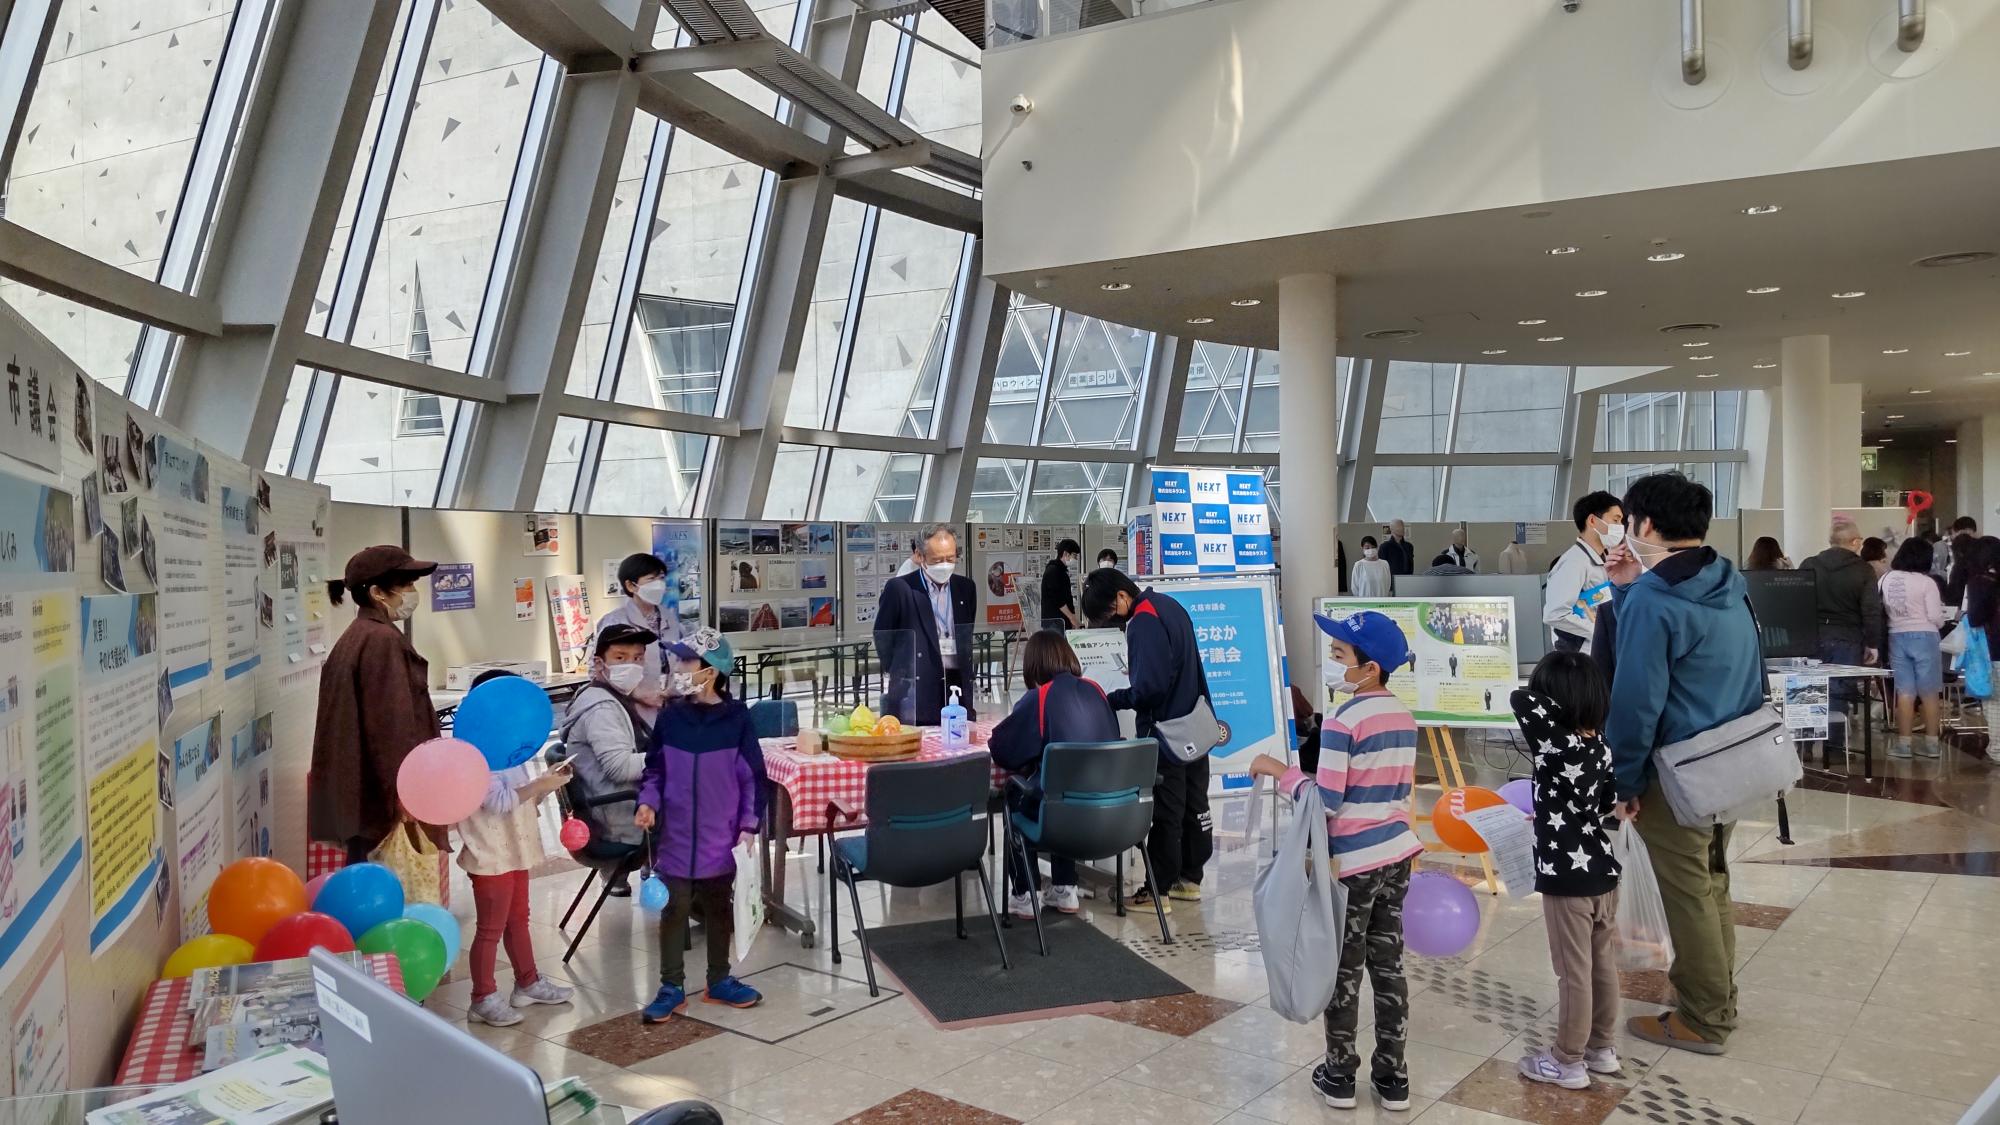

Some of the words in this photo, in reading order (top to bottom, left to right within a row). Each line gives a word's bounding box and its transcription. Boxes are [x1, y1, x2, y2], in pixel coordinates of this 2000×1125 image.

[1070, 372, 1116, 385] 産業まつり
[7, 353, 57, 444] 市議会
[1197, 482, 1221, 492] NEXT
[1162, 512, 1187, 522] NEXT
[1237, 514, 1262, 523] NEXT
[1203, 543, 1228, 552] NEXT
[1194, 624, 1238, 642] ちなか
